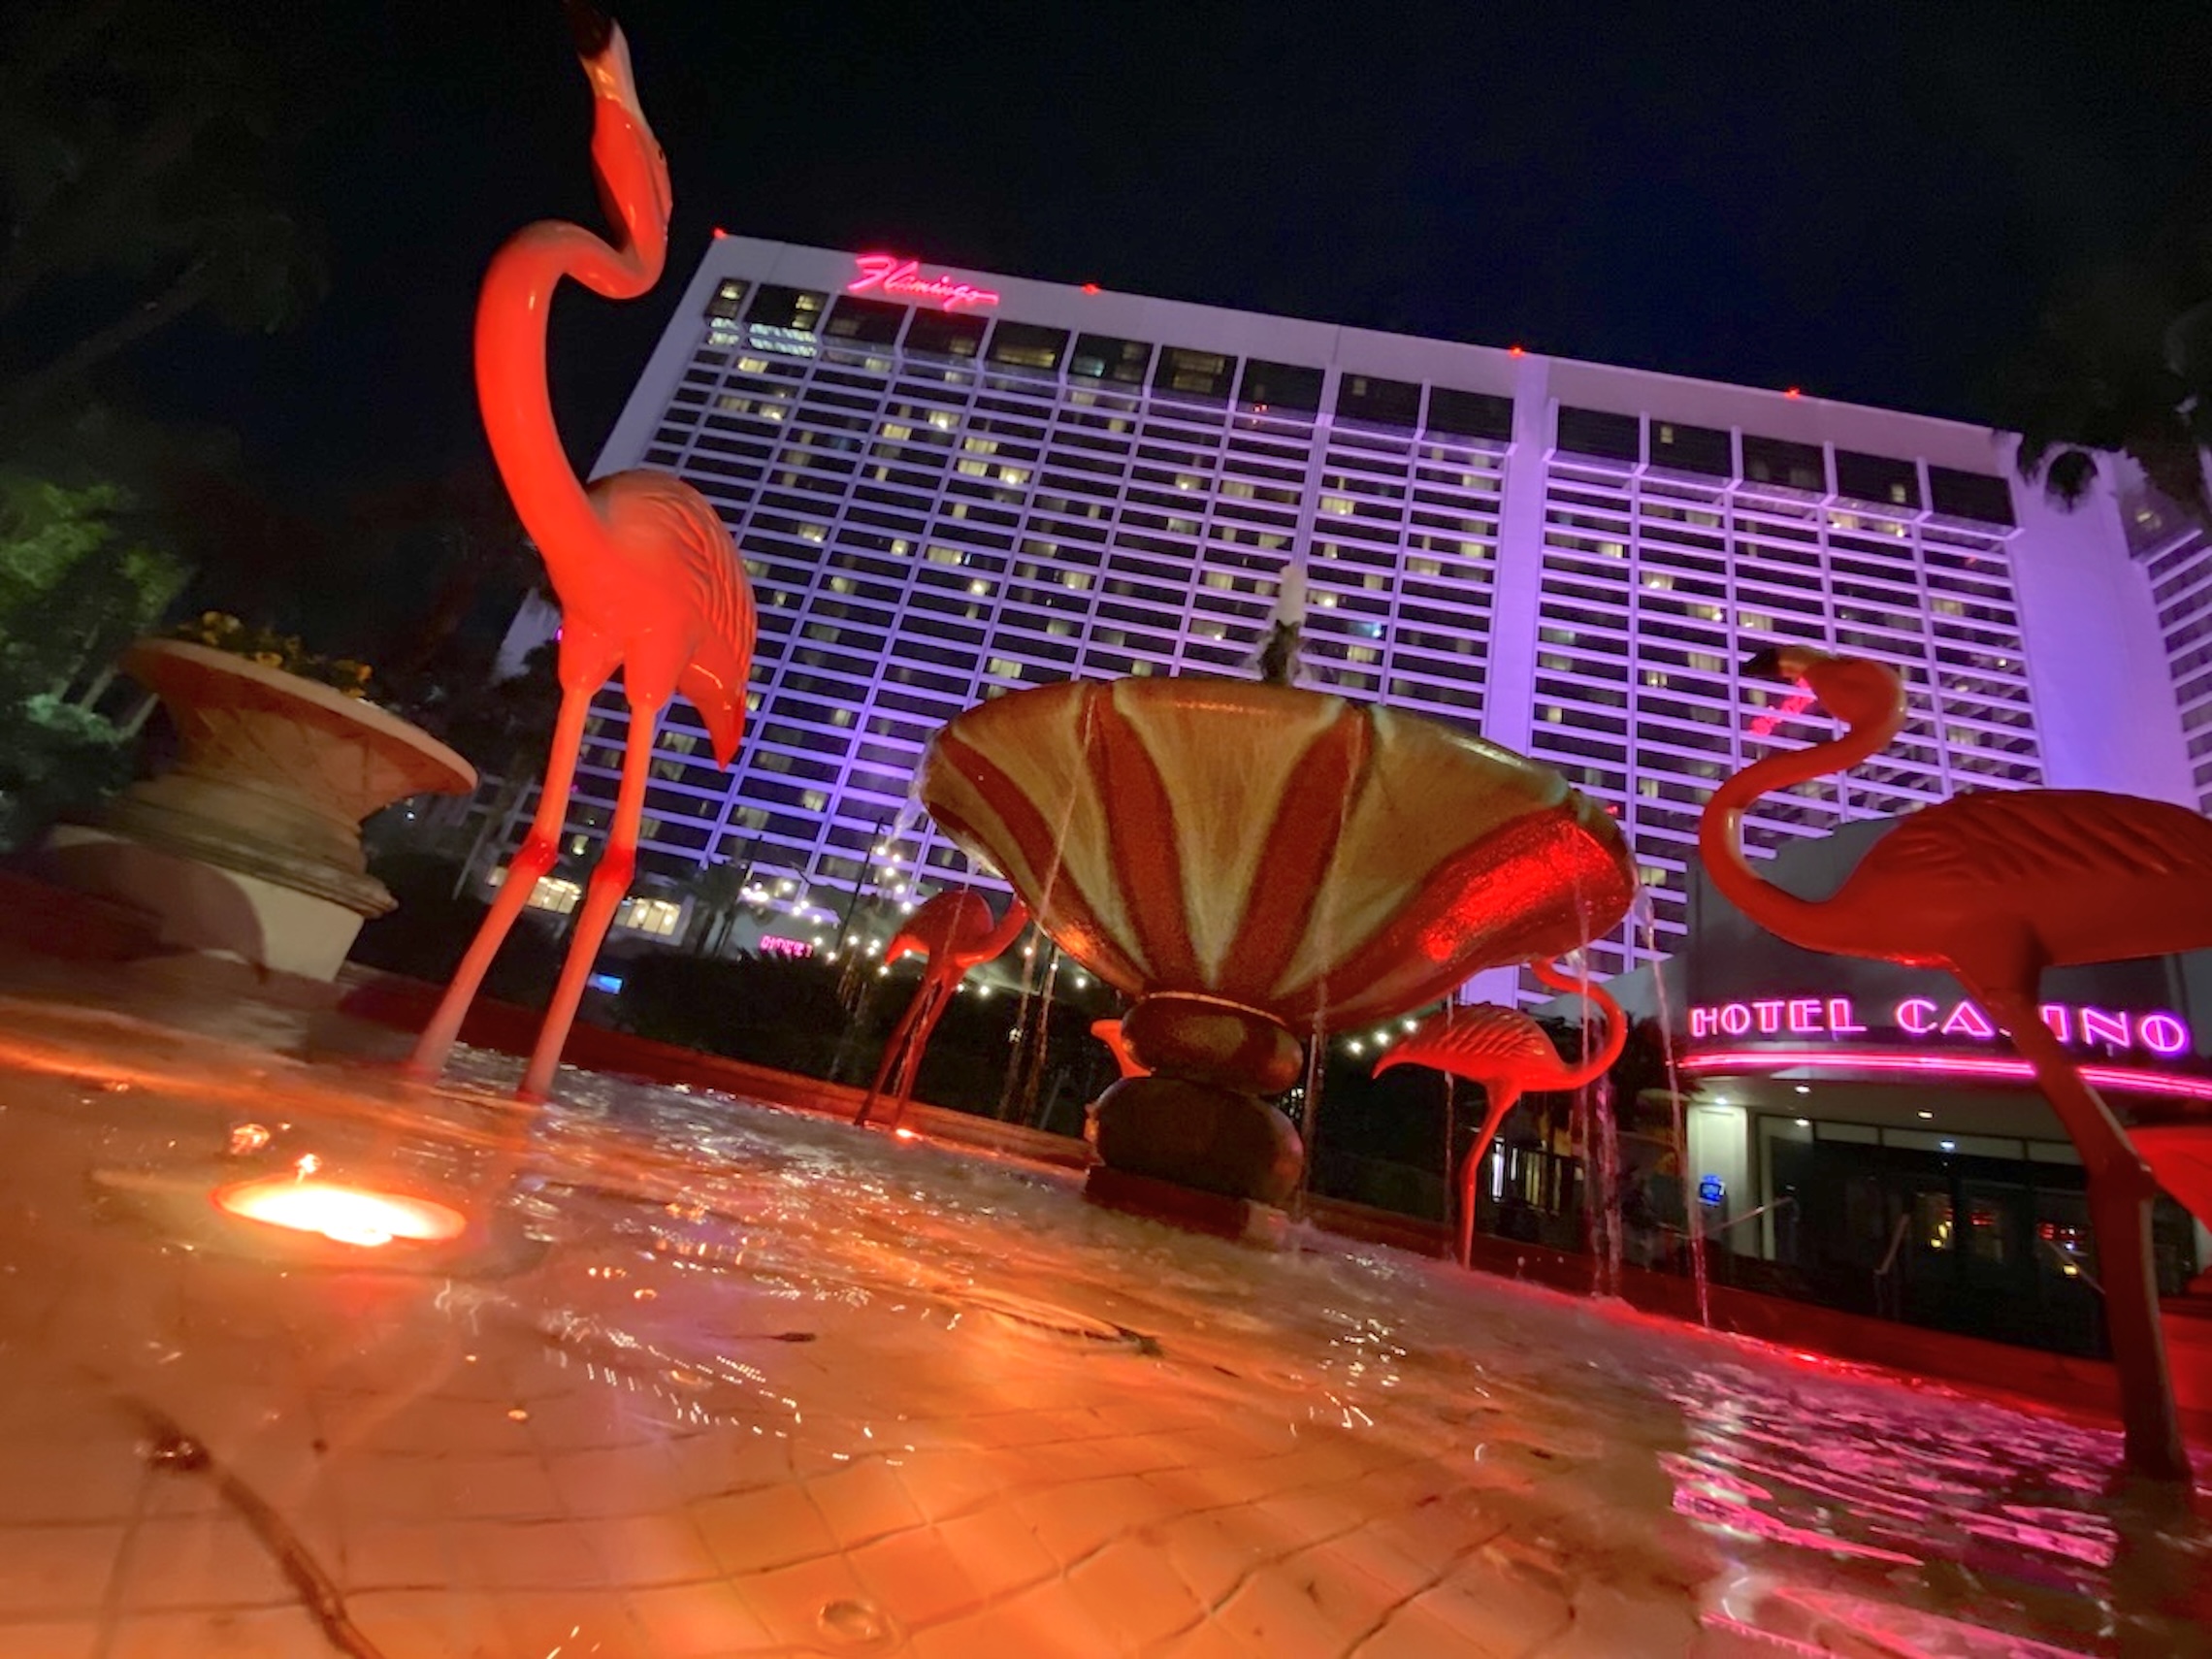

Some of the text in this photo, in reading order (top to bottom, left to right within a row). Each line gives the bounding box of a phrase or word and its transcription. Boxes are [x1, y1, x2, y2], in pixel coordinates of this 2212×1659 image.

[847, 254, 999, 311] Flamingo
[1691, 997, 2185, 1053] HOTEL CAINO
